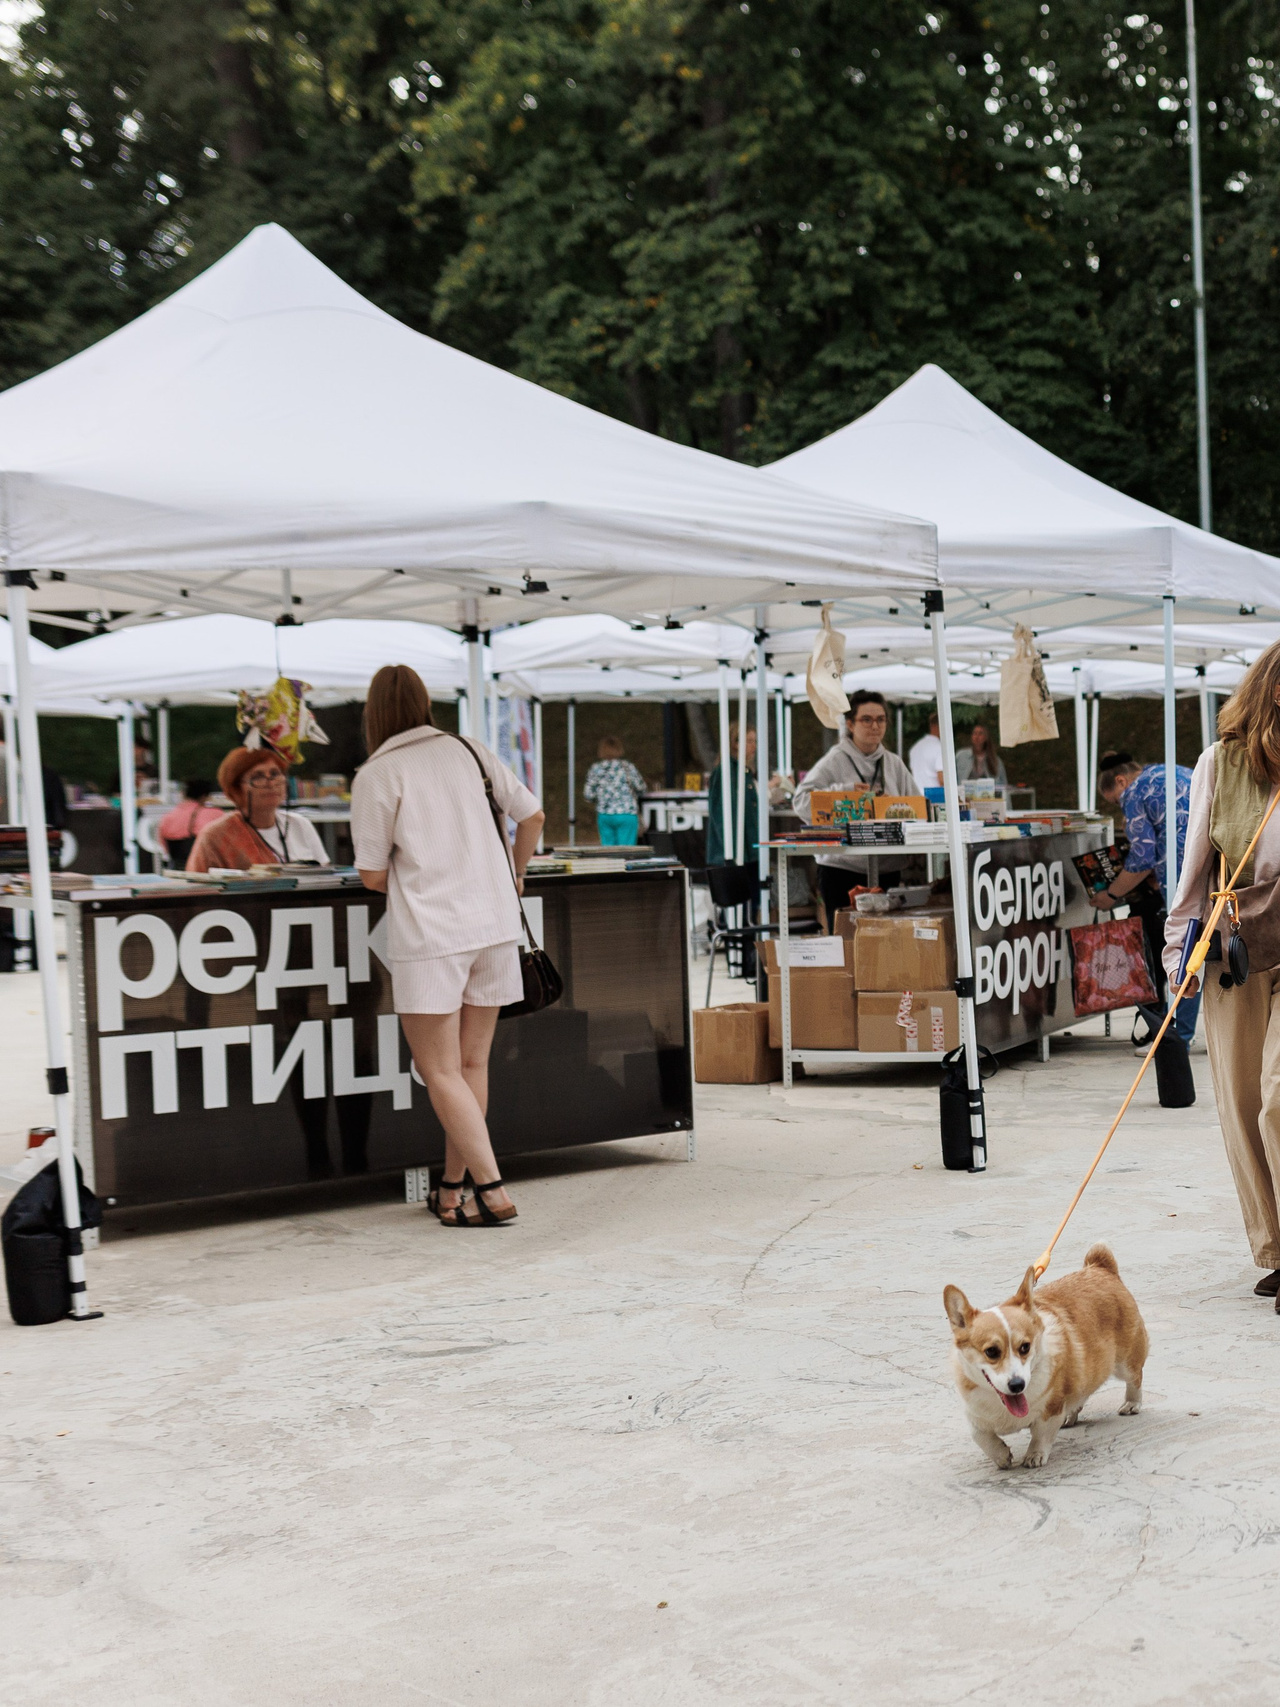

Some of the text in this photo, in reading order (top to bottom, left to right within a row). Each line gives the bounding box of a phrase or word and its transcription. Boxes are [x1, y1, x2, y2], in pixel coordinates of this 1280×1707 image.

[973, 848, 1065, 931] белая
[1095, 849, 1116, 881] ФАЛЬТ!
[95, 895, 544, 1032] редк
[975, 926, 1073, 1016] ворон
[101, 1014, 428, 1120] птиц
